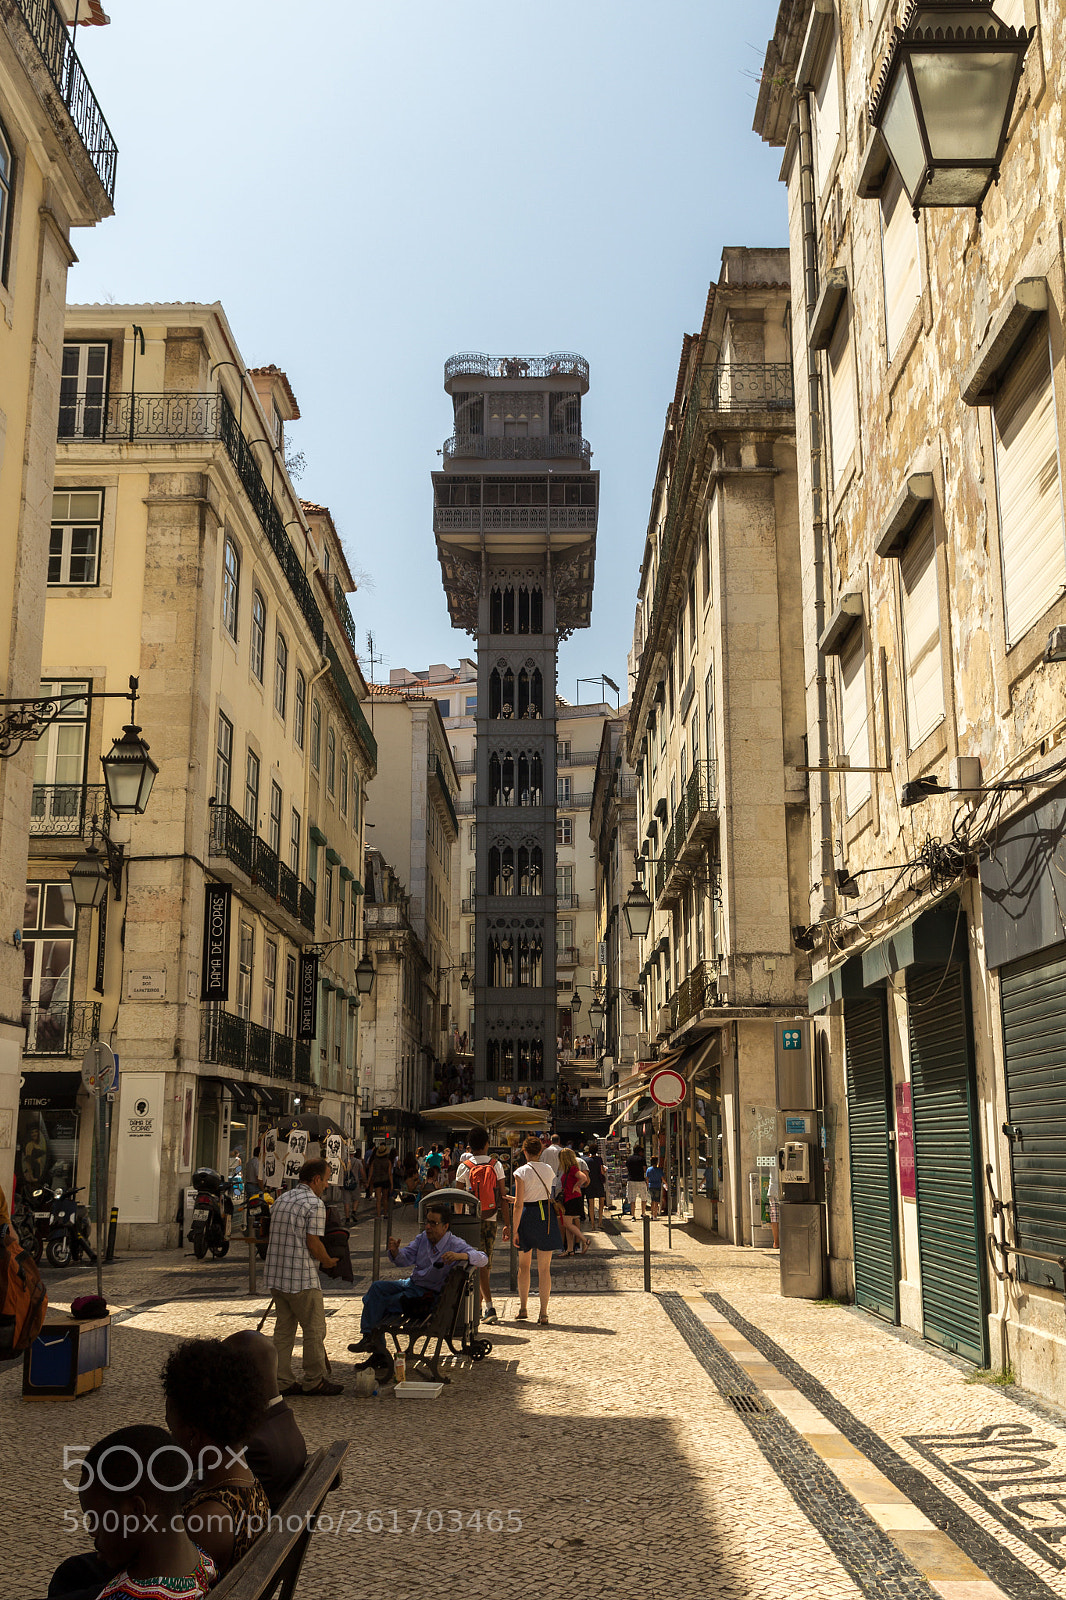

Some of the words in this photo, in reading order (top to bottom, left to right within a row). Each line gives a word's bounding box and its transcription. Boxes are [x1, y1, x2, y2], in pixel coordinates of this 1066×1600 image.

[211, 940, 222, 954] DE
[210, 959, 222, 987] DAMA
[303, 995, 312, 1006] DE
[302, 1009, 312, 1031] DAMA
[785, 1040, 798, 1048] PT
